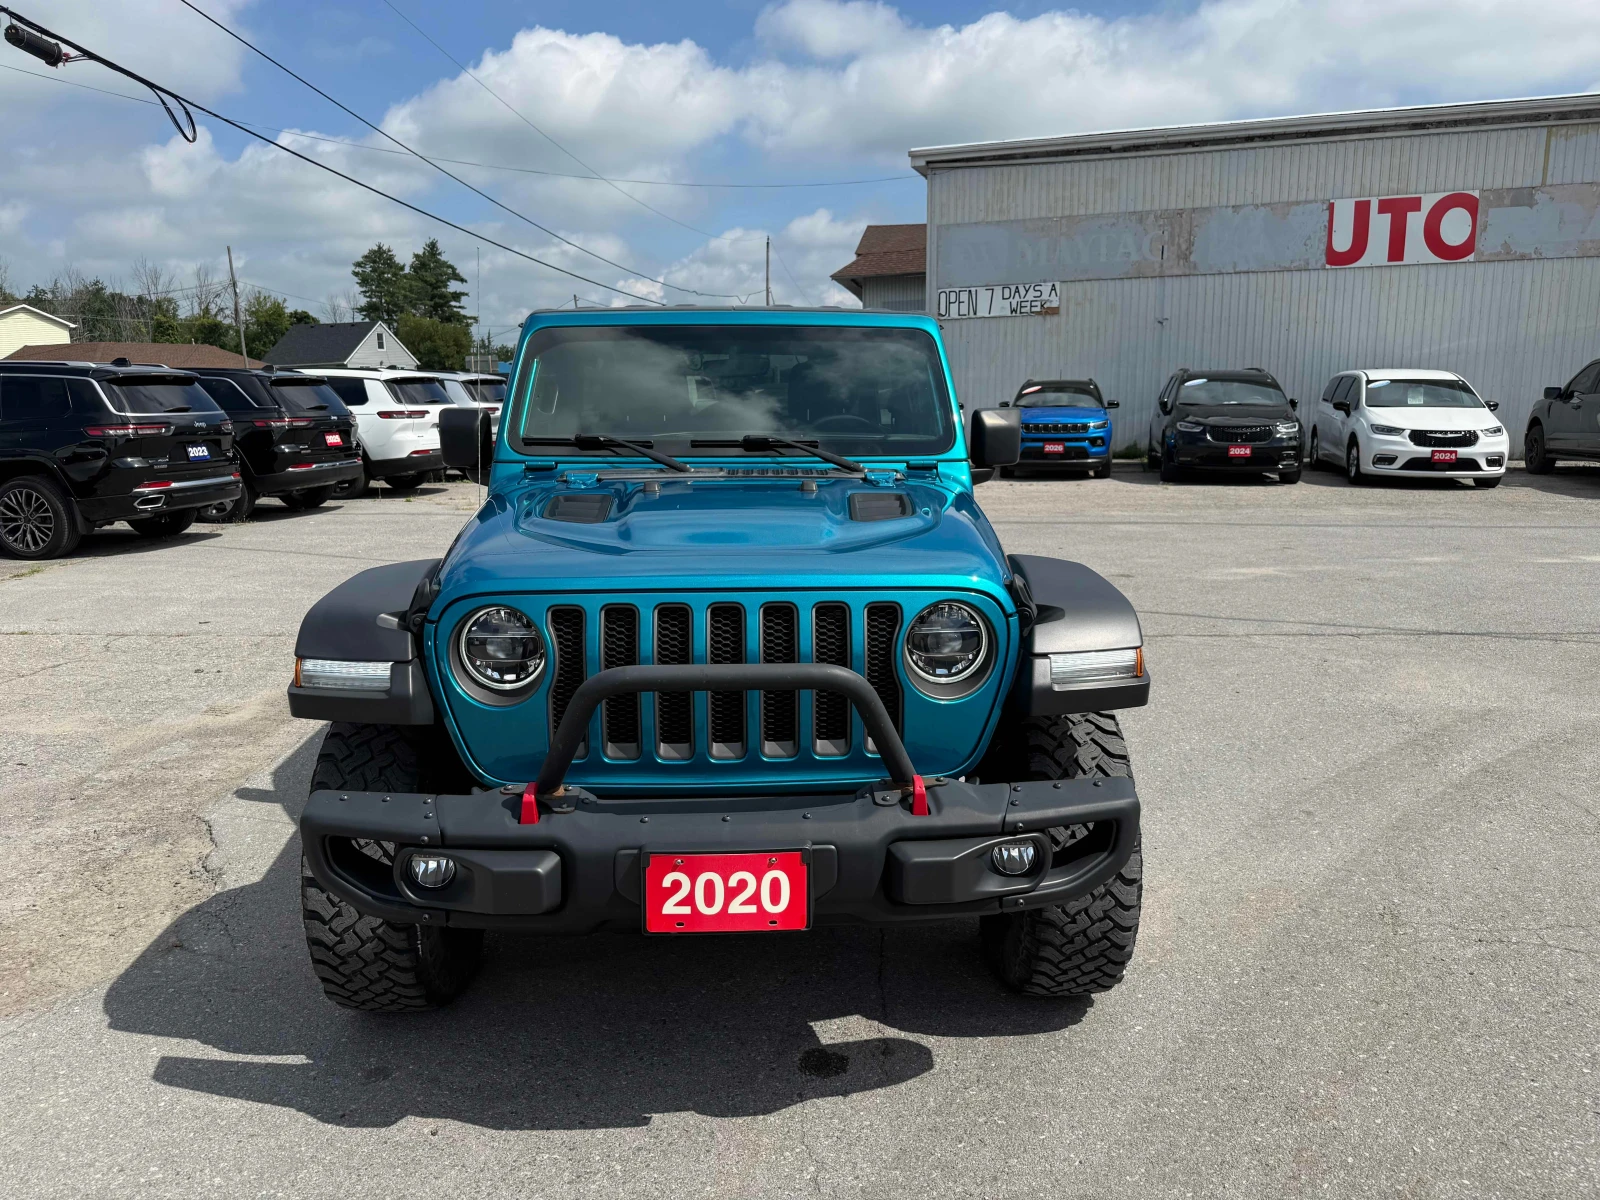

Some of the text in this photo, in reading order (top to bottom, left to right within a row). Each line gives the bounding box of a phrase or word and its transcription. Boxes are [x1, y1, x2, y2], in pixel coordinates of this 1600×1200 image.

[1326, 192, 1479, 267] UTO
[938, 283, 1059, 318] OPEN 7 DAYS A
[188, 446, 209, 457] 2023
[1229, 447, 1251, 456] 2024
[1433, 452, 1456, 460] 2024
[661, 869, 791, 916] 2020
